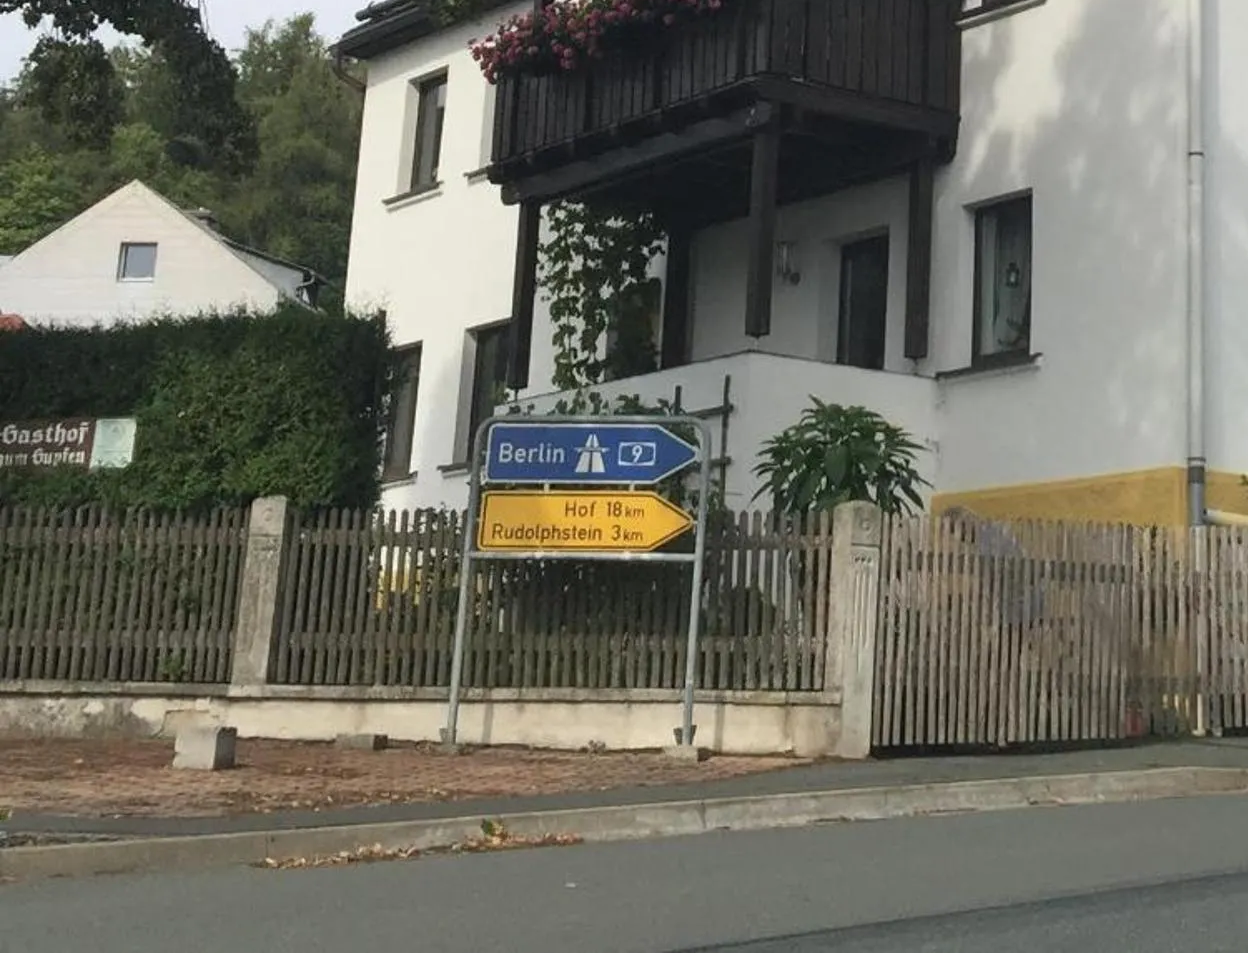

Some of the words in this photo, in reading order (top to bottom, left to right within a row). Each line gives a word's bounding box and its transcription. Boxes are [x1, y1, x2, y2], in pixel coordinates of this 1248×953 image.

[1, 421, 90, 446] Gasthof
[499, 442, 565, 464] Berlin
[631, 444, 643, 464] 9
[564, 500, 597, 518] Hof
[607, 500, 622, 518] 18
[624, 505, 645, 519] km
[491, 522, 602, 543] Rudolphstein
[611, 524, 621, 542] 3
[623, 528, 643, 542] km
